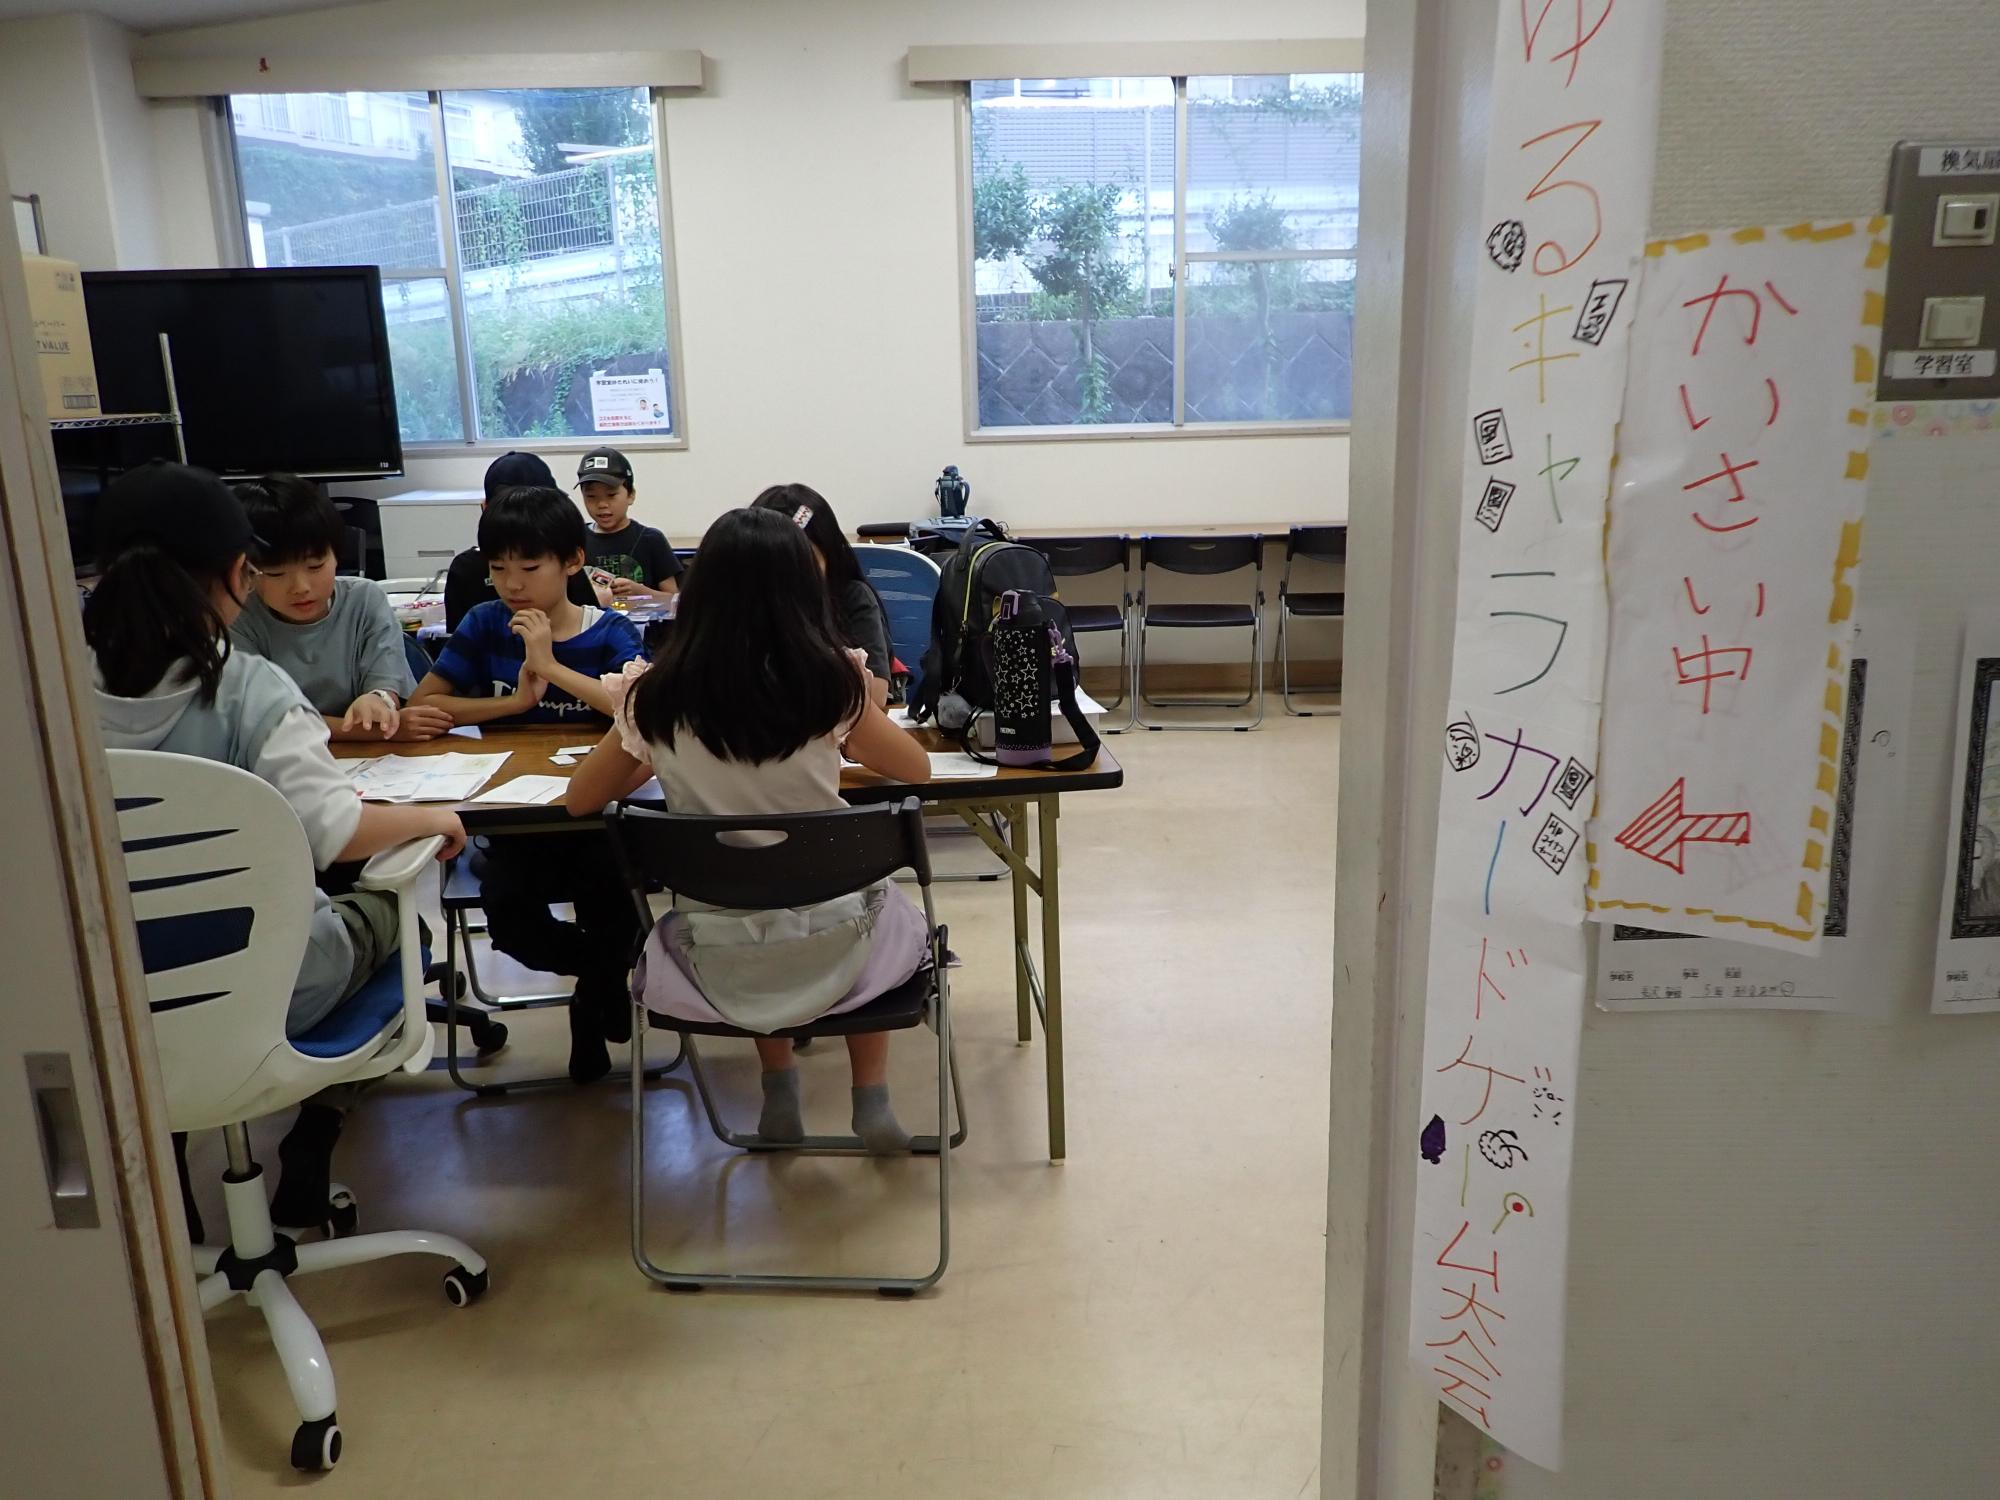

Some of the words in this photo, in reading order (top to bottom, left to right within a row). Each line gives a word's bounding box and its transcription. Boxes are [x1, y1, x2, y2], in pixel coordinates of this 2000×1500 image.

[1914, 355, 1975, 375] 学習室
[1672, 274, 1799, 714] かいさい中
